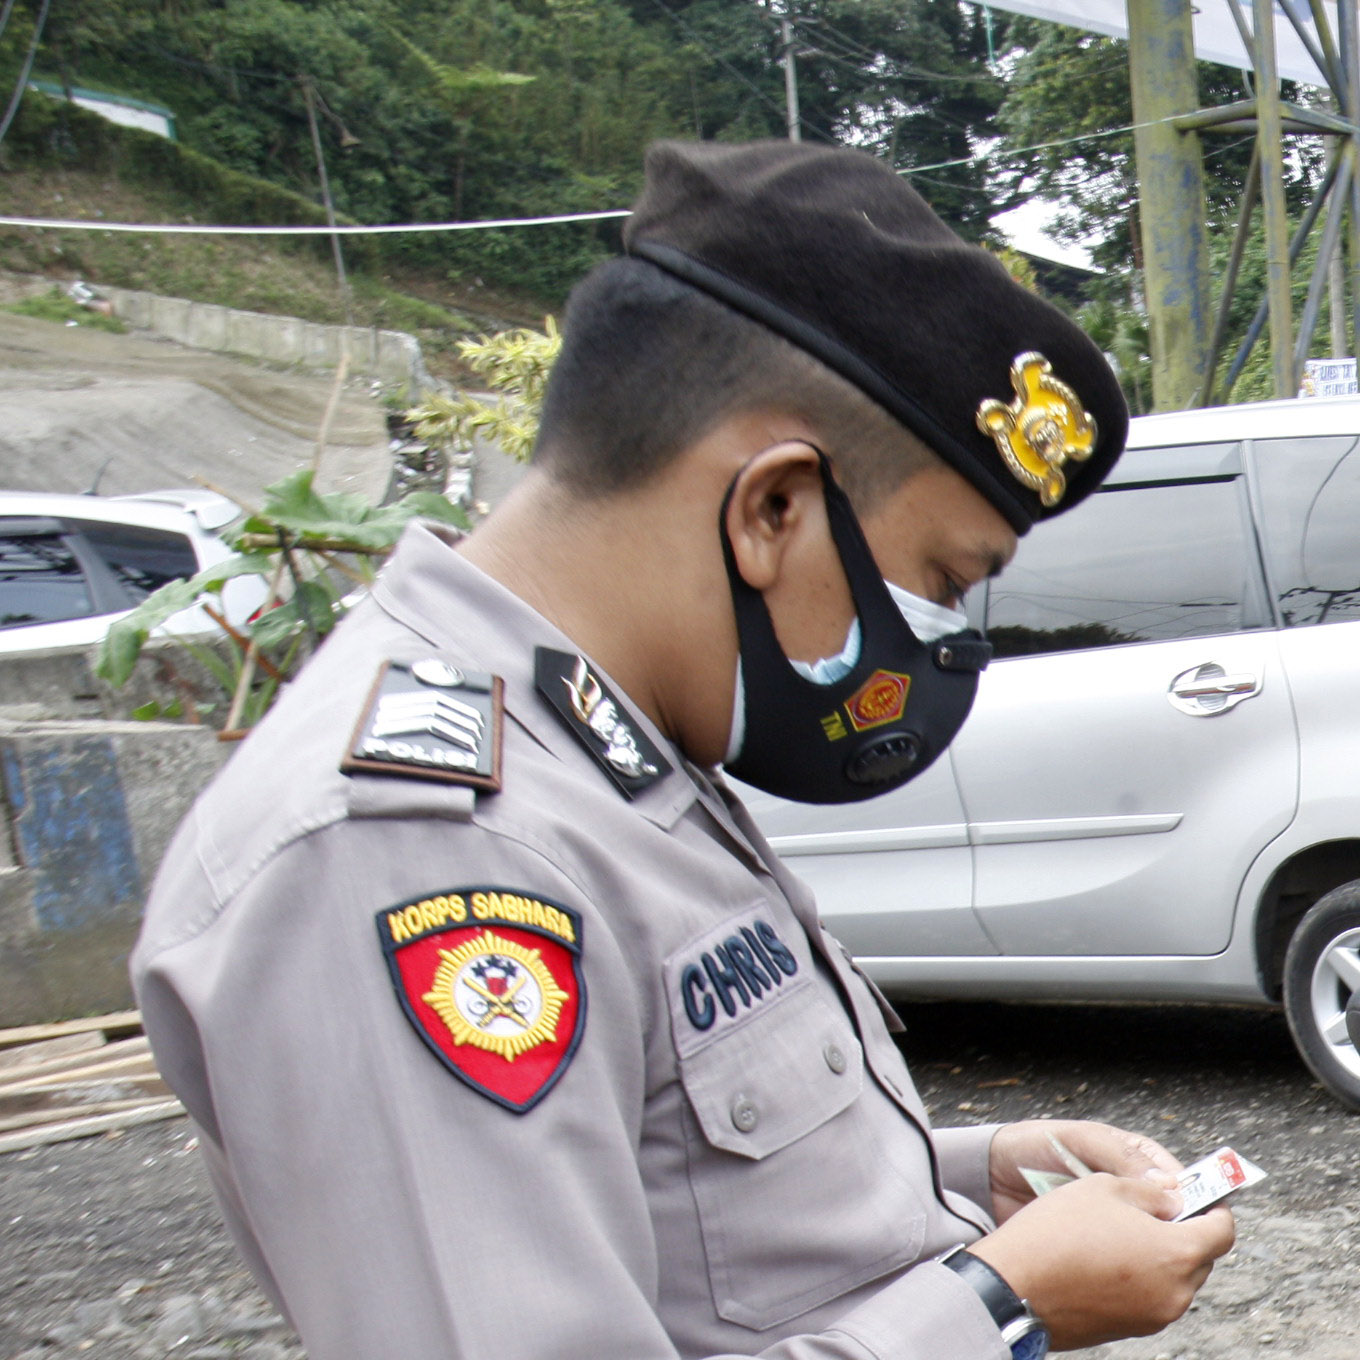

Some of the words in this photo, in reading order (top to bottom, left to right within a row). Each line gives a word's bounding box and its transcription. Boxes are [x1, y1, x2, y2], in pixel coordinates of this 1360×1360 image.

[820, 710, 848, 742] TNI
[362, 736, 478, 770] POLISI
[387, 894, 468, 943] KORPS
[471, 891, 576, 943] SABHARA
[679, 918, 799, 1032] CHRIS
